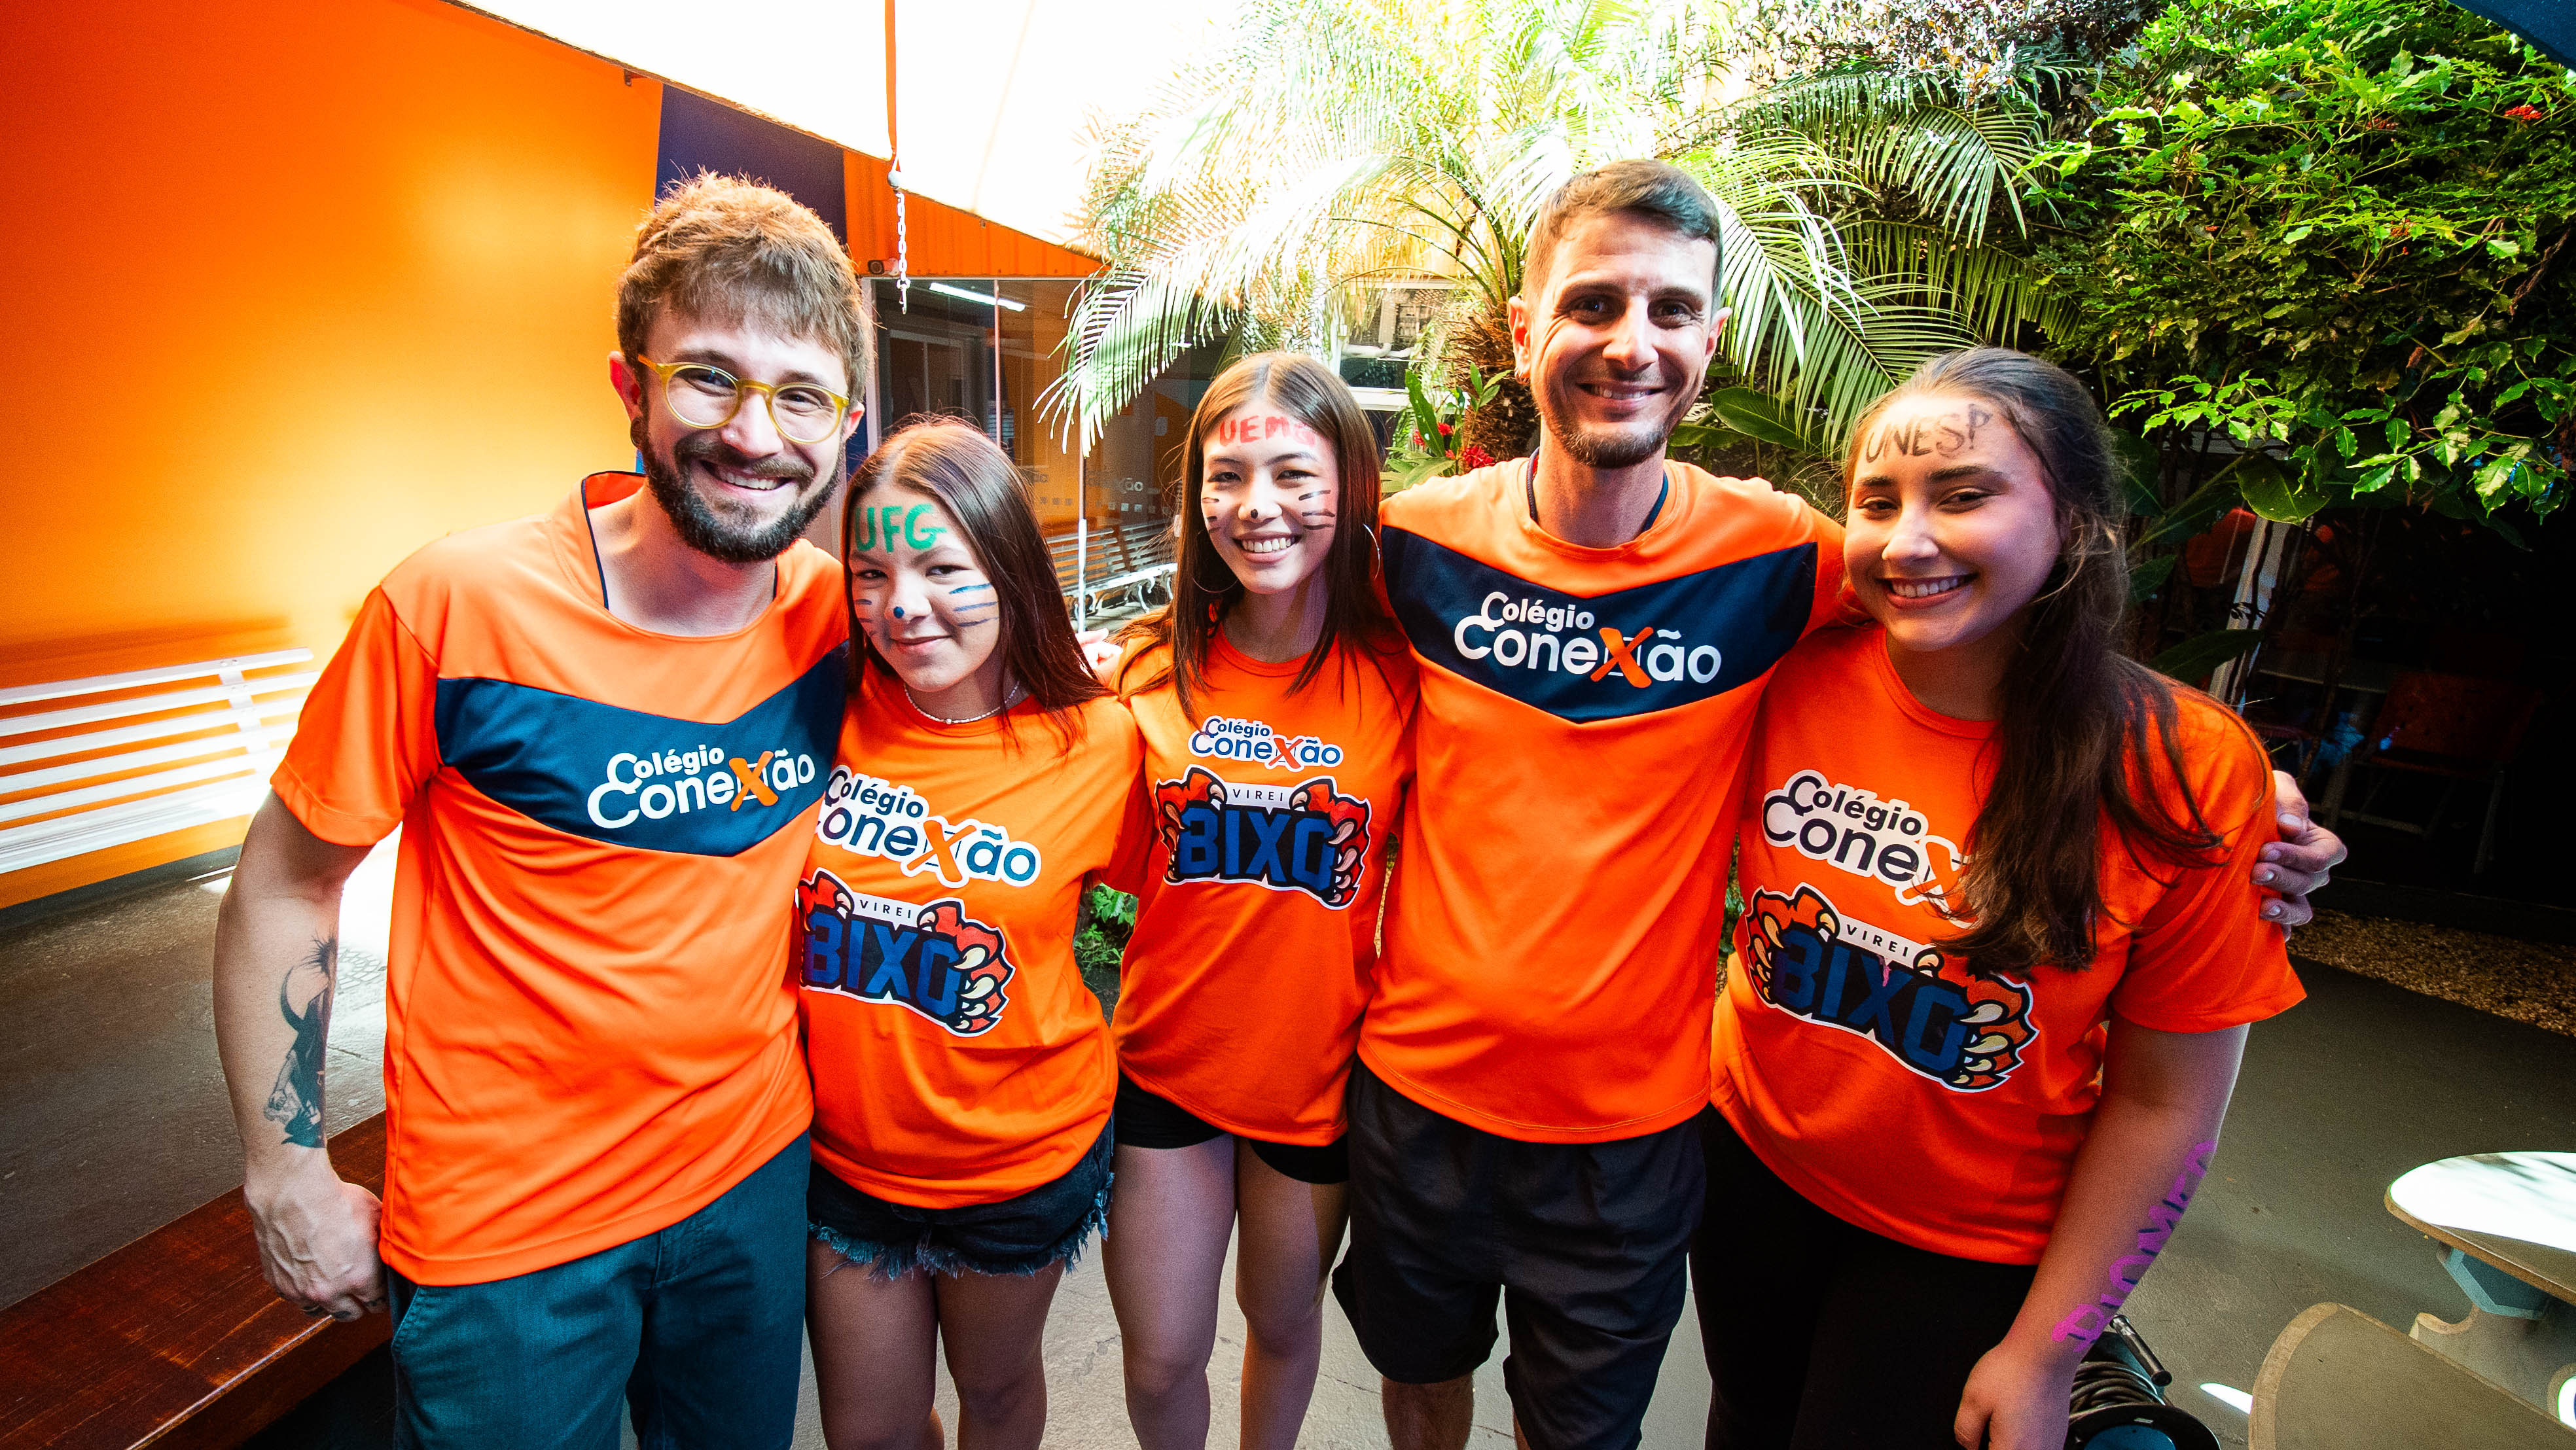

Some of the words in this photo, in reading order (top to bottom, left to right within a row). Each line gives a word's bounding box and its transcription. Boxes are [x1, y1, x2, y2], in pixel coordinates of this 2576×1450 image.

[1866, 403, 1994, 463] UNESP
[854, 503, 947, 553] UFG
[1480, 592, 1595, 632] Colégio
[1206, 718, 1270, 739] Colégio
[607, 744, 724, 788] Colégio
[825, 769, 923, 818] Colégio
[1233, 789, 1283, 802] VIREI
[1789, 775, 1922, 836] Colégio
[817, 807, 1036, 883] oneXão
[1179, 807, 1336, 891] BIXO
[1762, 795, 1978, 924] ConeX
[859, 899, 911, 919] VIREI
[1846, 924, 1910, 958] VIREI
